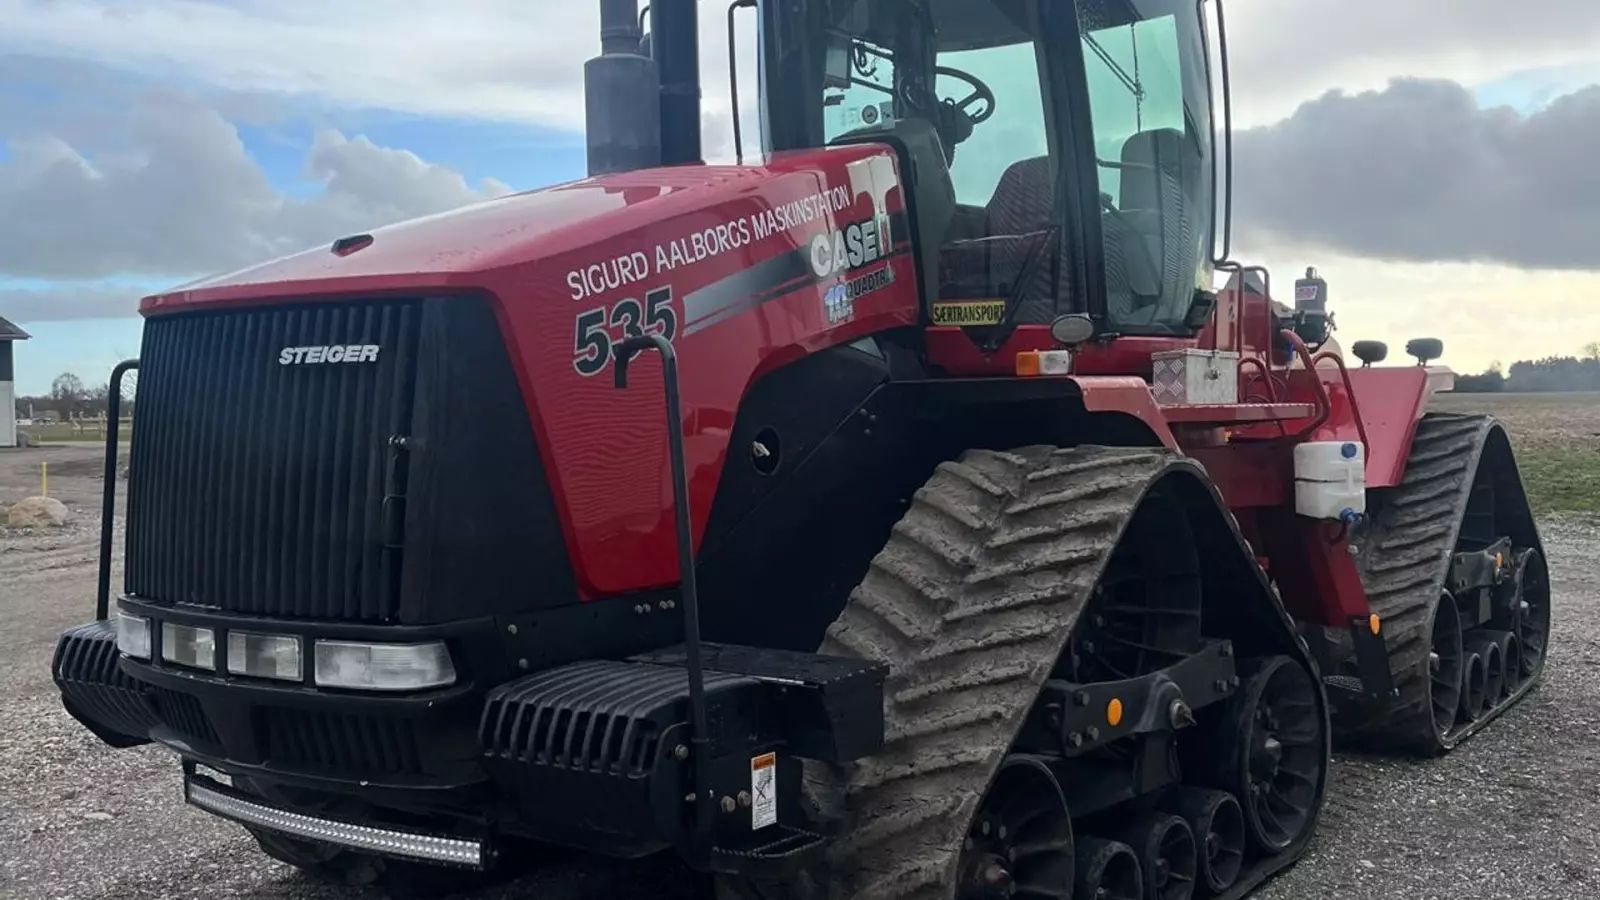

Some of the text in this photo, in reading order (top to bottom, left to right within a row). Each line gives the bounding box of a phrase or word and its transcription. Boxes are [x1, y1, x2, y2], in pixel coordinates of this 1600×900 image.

[567, 184, 851, 300] SIGURD AALBORGS MASKINSTATION
[810, 220, 878, 277] CASE
[573, 284, 677, 377] 535
[934, 304, 1005, 323] SÆRTRANSPORT
[279, 344, 380, 365] STEIGER
